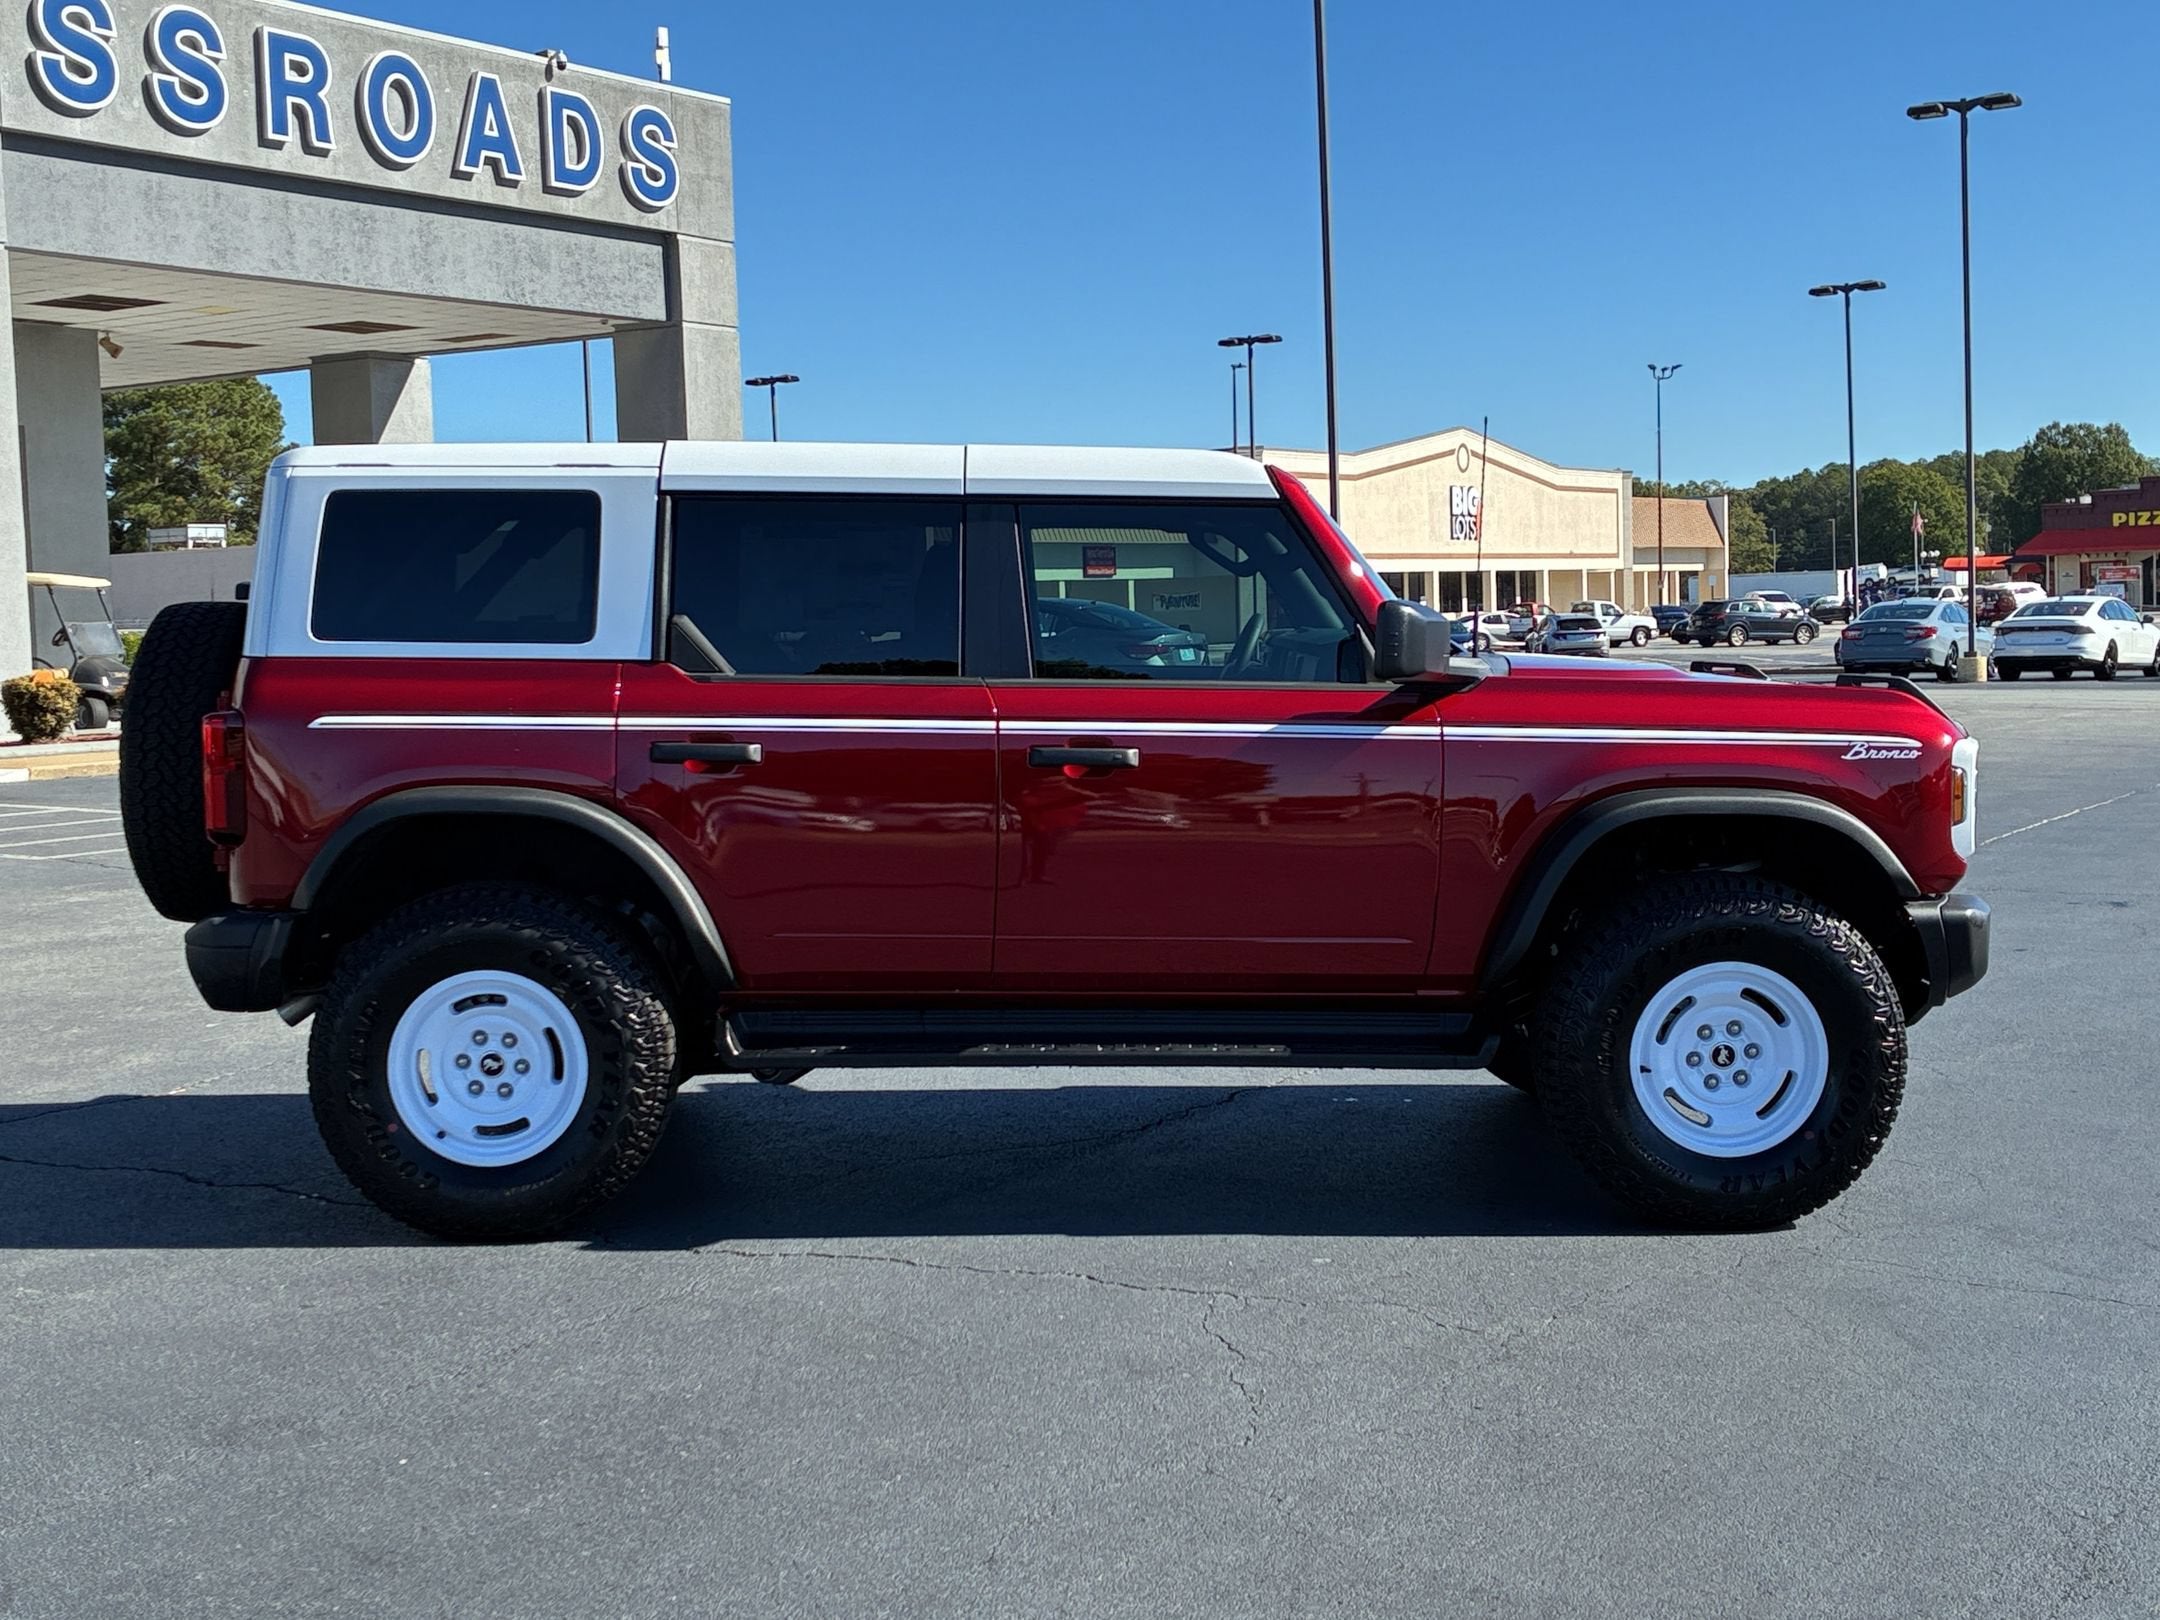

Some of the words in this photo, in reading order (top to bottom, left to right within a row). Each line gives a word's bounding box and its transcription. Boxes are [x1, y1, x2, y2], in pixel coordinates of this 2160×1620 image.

[30, 0, 680, 209] SSROADS
[1450, 485, 1482, 515] BIG
[1451, 515, 1478, 540] LOTS
[1841, 741, 1922, 760] Bronco
